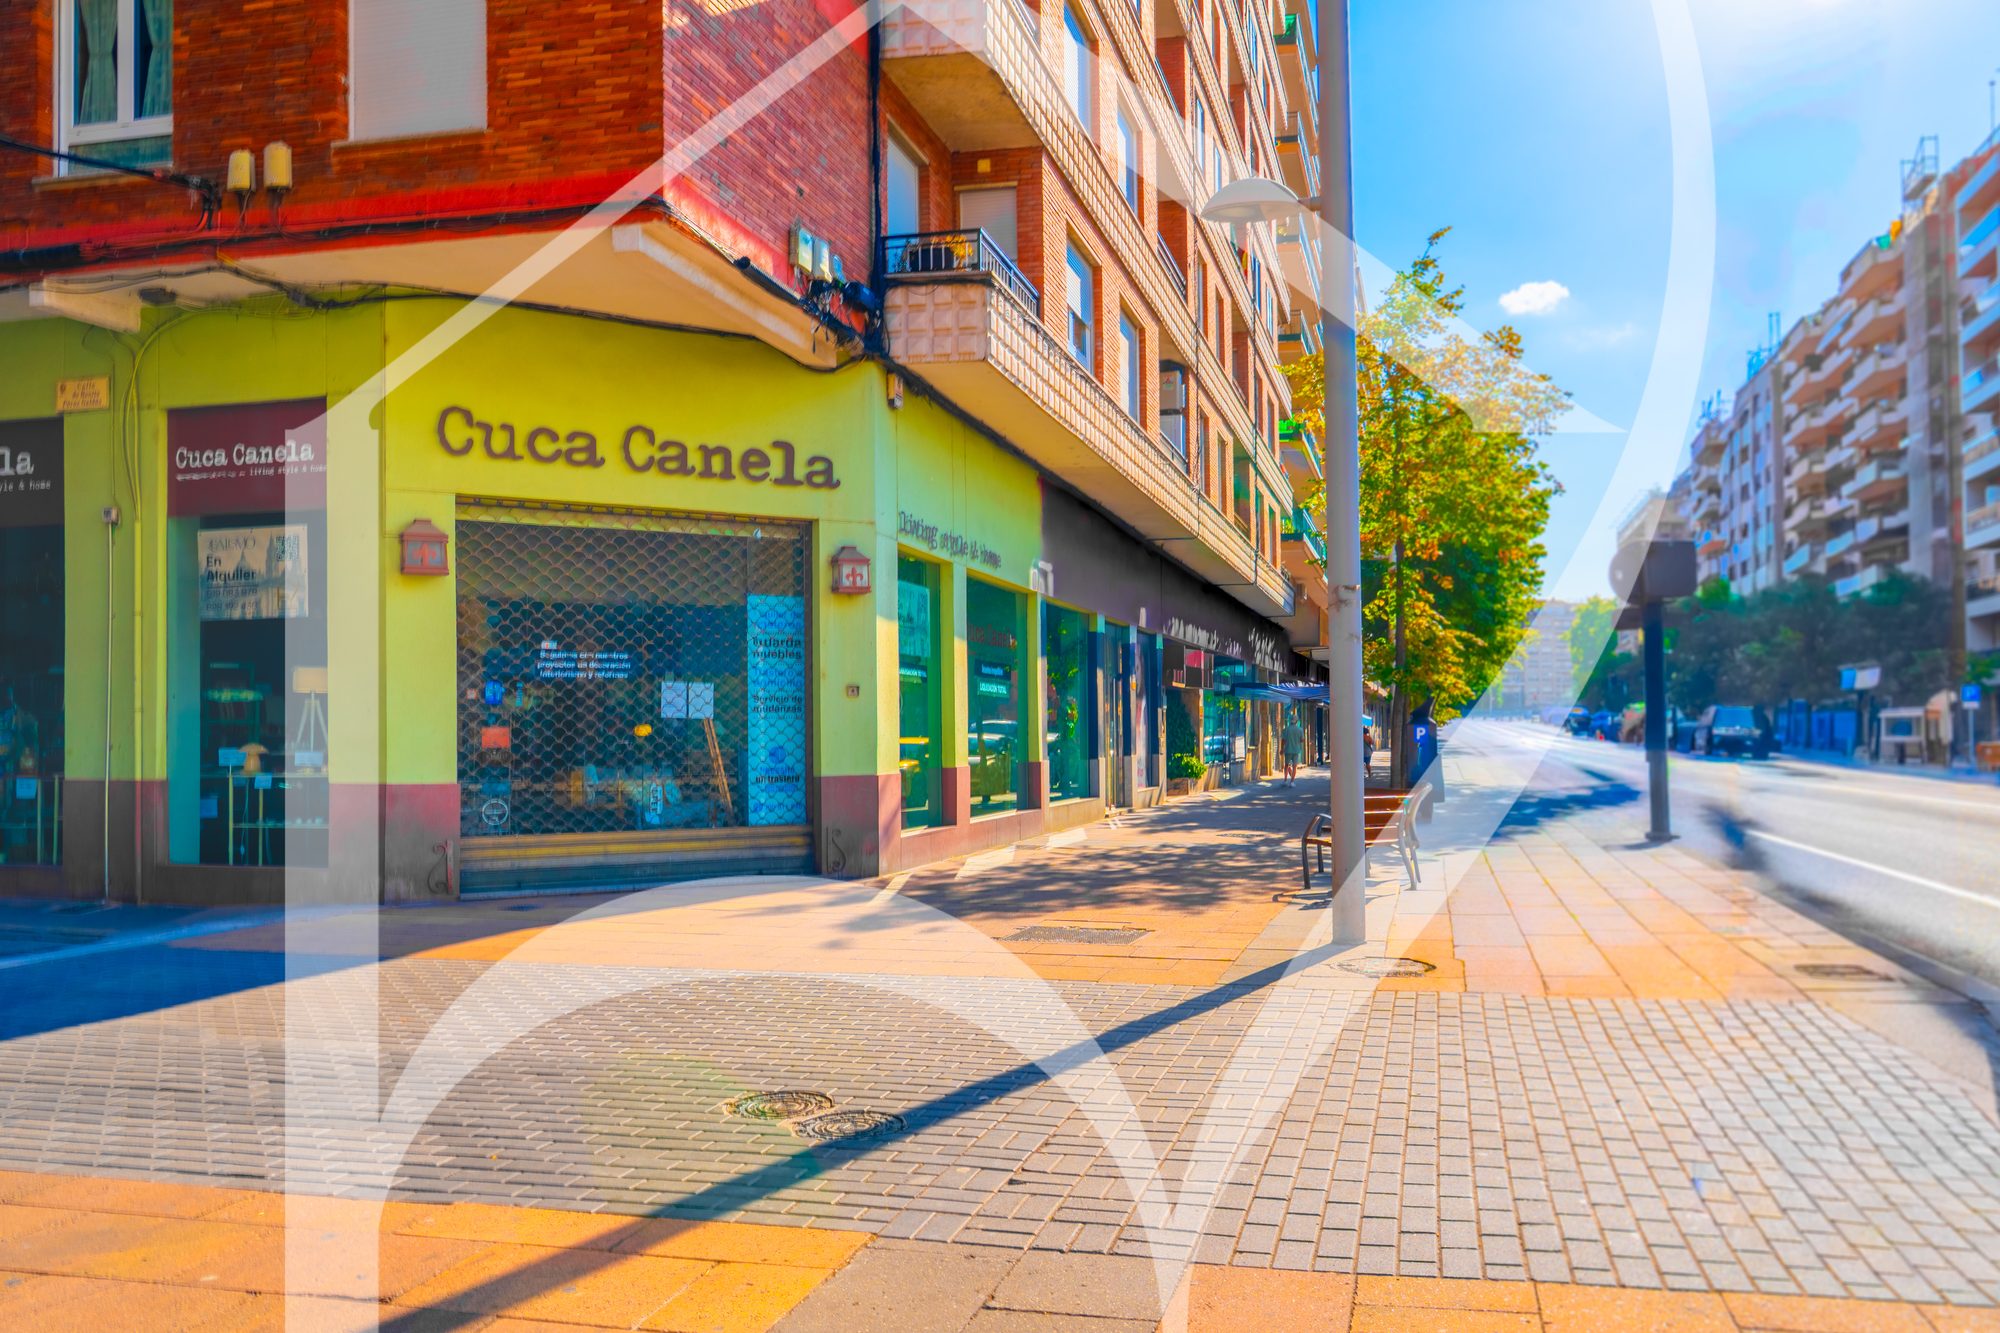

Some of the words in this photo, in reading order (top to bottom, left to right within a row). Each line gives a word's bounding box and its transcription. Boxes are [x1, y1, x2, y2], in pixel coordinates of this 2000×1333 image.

[175, 446, 228, 469] Cuca
[233, 440, 315, 466] Canela
[437, 406, 606, 468] Cuca
[622, 425, 841, 489] Canela
[206, 556, 221, 567] En
[206, 568, 257, 584] Alquiler
[1416, 727, 1426, 740] P
